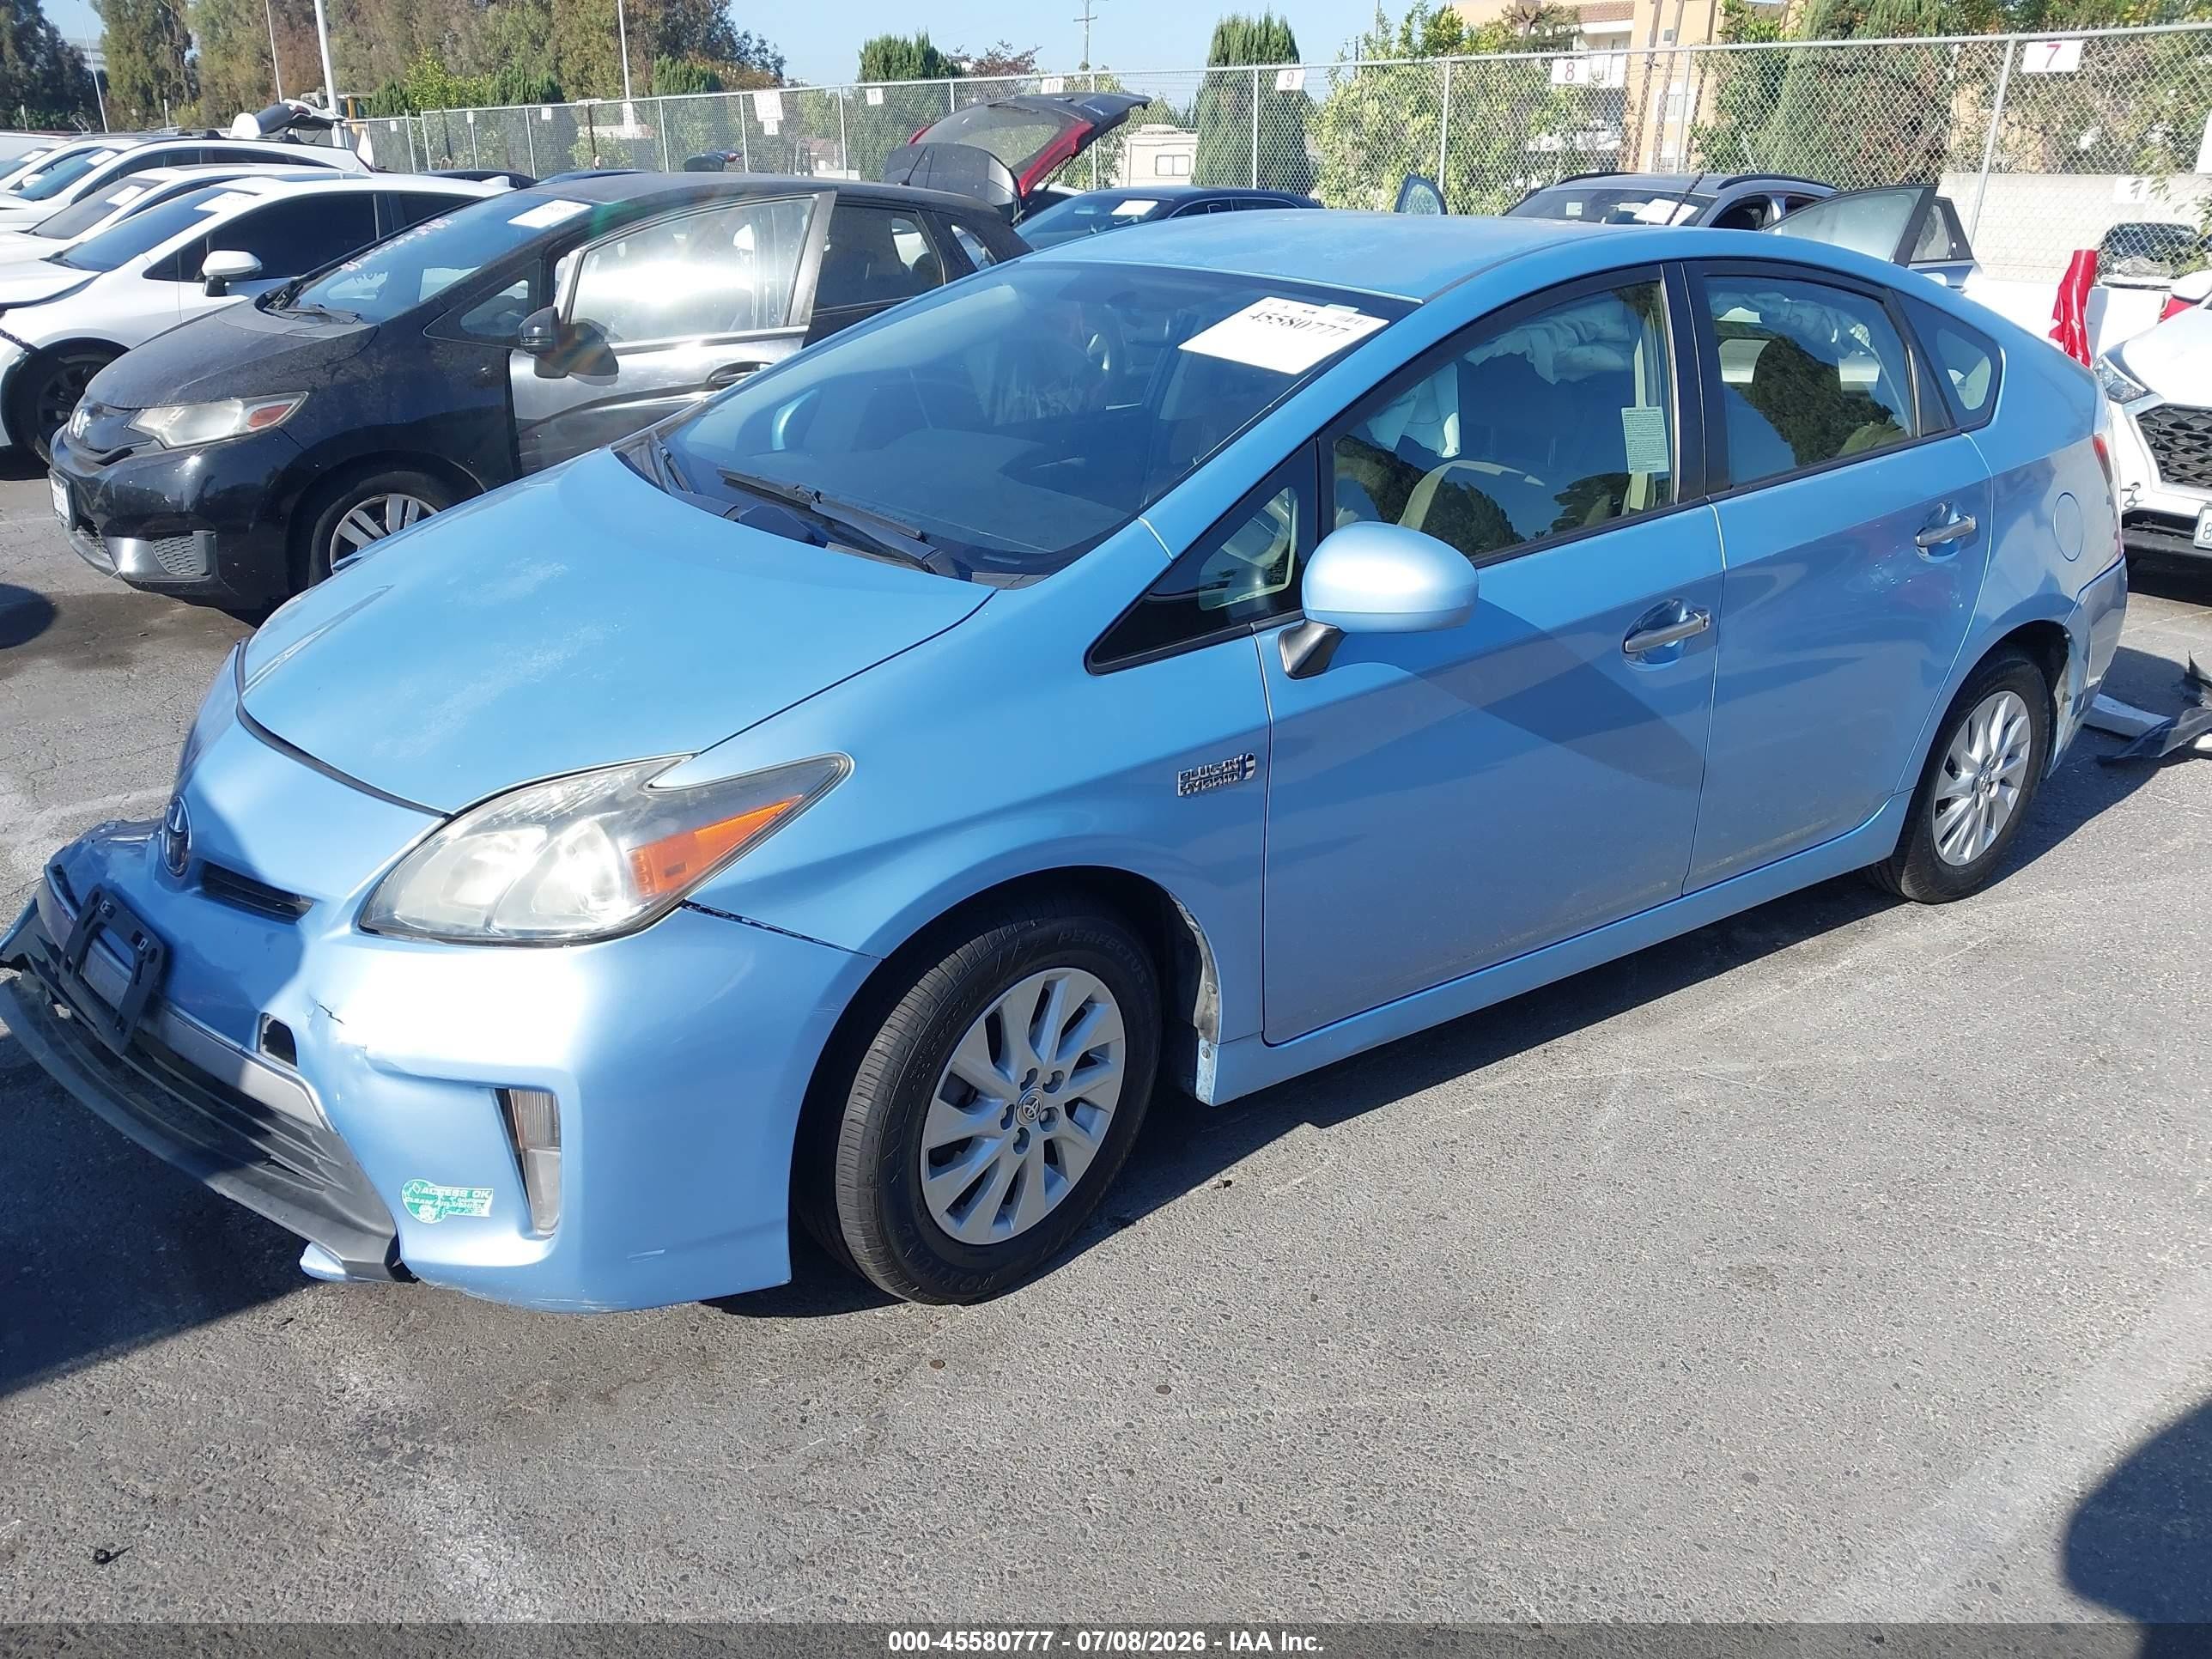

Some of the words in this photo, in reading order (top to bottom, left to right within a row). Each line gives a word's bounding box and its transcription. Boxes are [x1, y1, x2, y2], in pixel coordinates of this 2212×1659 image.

[2045, 43, 2062, 69] 7
[1285, 70, 1295, 88] 9
[1565, 61, 1576, 82] 8
[1249, 310, 1352, 337] 45580777
[421, 1188, 469, 1198] ACCESS
[471, 1190, 489, 1199] OK
